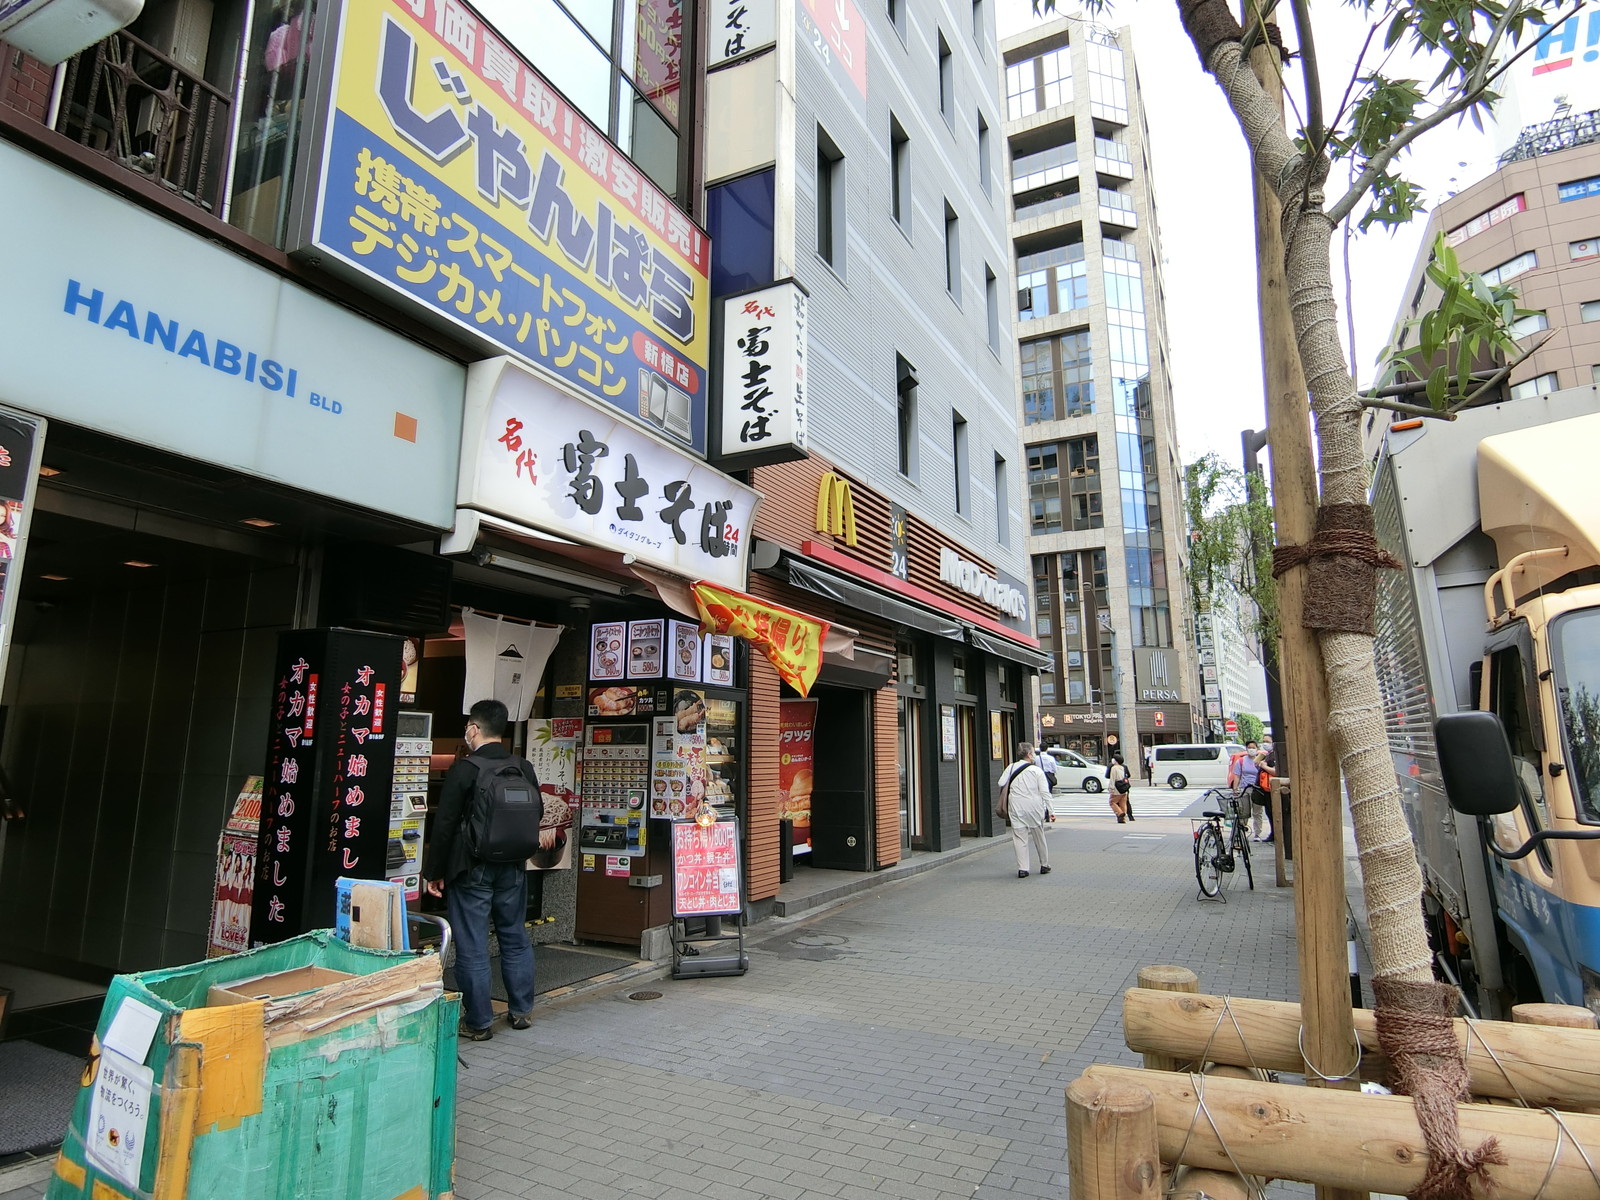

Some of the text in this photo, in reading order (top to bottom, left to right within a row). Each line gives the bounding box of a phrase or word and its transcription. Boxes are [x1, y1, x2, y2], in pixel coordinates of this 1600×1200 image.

[813, 27, 831, 66] 24
[376, 12, 694, 343] じゃんぱら
[356, 147, 629, 353] 携帯・スマートフォン
[349, 205, 627, 396] デジカメ・パソコン
[741, 300, 775, 320] 名代
[63, 279, 342, 415] HANABISI BLD
[645, 340, 689, 388] 新橋店
[737, 326, 779, 443] 富士そば
[498, 418, 538, 486] 名代
[563, 429, 733, 558] 富士そば
[724, 524, 739, 543] 24
[891, 552, 906, 579] 24
[305, 682, 317, 730] 女性歓迎
[374, 689, 384, 727] 女性歓迎
[1143, 690, 1178, 699] PERSA
[268, 658, 309, 922] オカマ始めました
[327, 682, 352, 852] 女の子とニューハーフのお店
[677, 868, 719, 891] ワンコイン弁当
[680, 894, 736, 910] 天とじ丼・肉とじ丼
[100, 1085, 144, 1120] 物流をつくろう。
[103, 1066, 135, 1095] 世界が驚く、
